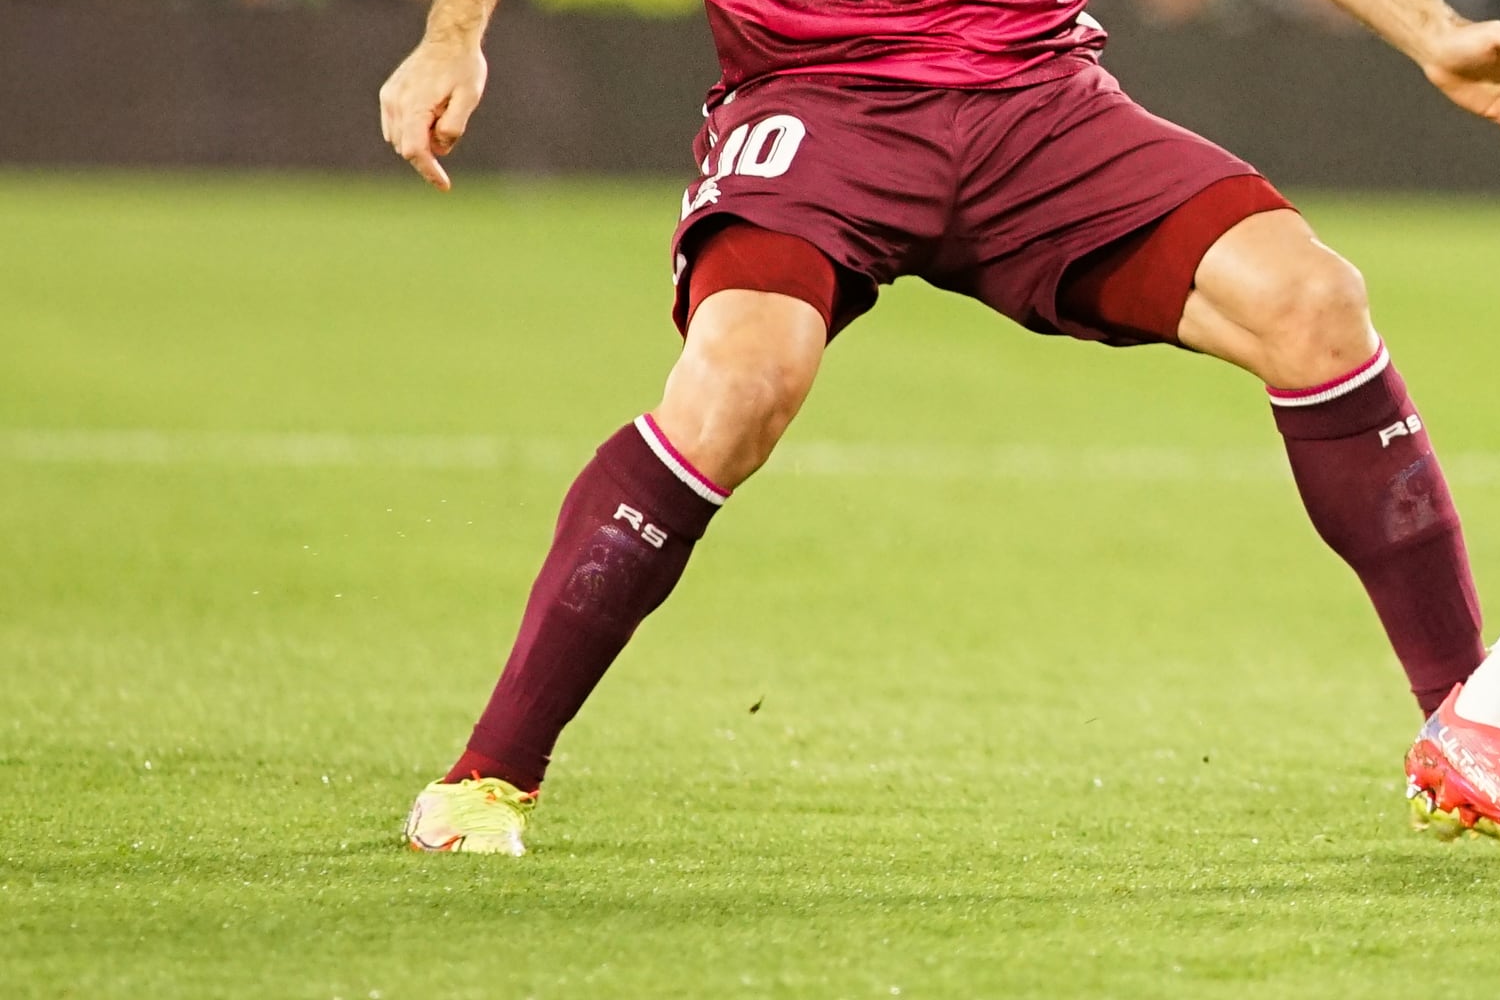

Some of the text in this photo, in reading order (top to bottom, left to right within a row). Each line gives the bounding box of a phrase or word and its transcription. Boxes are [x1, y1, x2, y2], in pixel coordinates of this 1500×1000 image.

[718, 114, 807, 179] 10
[1378, 413, 1423, 448] RS
[612, 502, 668, 550] RS
